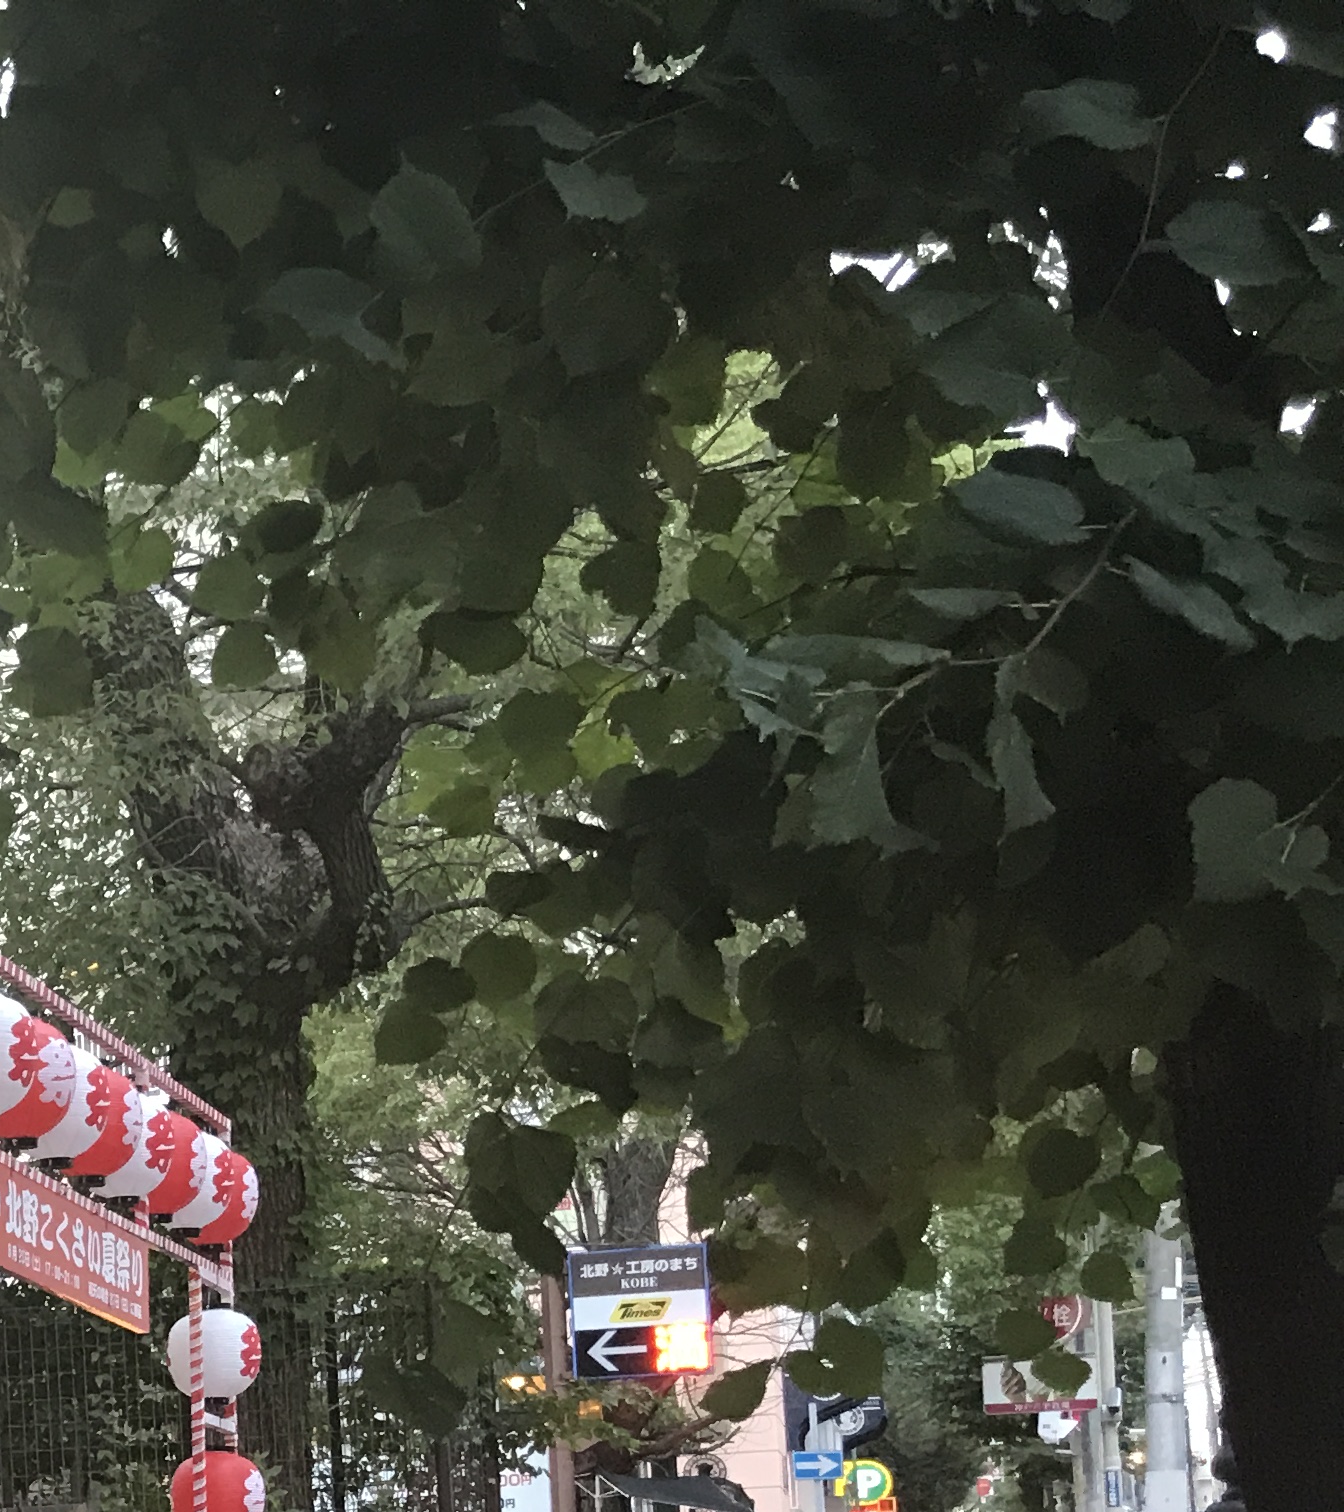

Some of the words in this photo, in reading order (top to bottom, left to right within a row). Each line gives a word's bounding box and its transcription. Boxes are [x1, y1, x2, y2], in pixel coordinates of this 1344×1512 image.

[5, 1178, 144, 1298] 北野こくさい夏祭り
[620, 1276, 658, 1289] KOBE
[618, 1300, 667, 1320] Times
[856, 1468, 882, 1499] P
